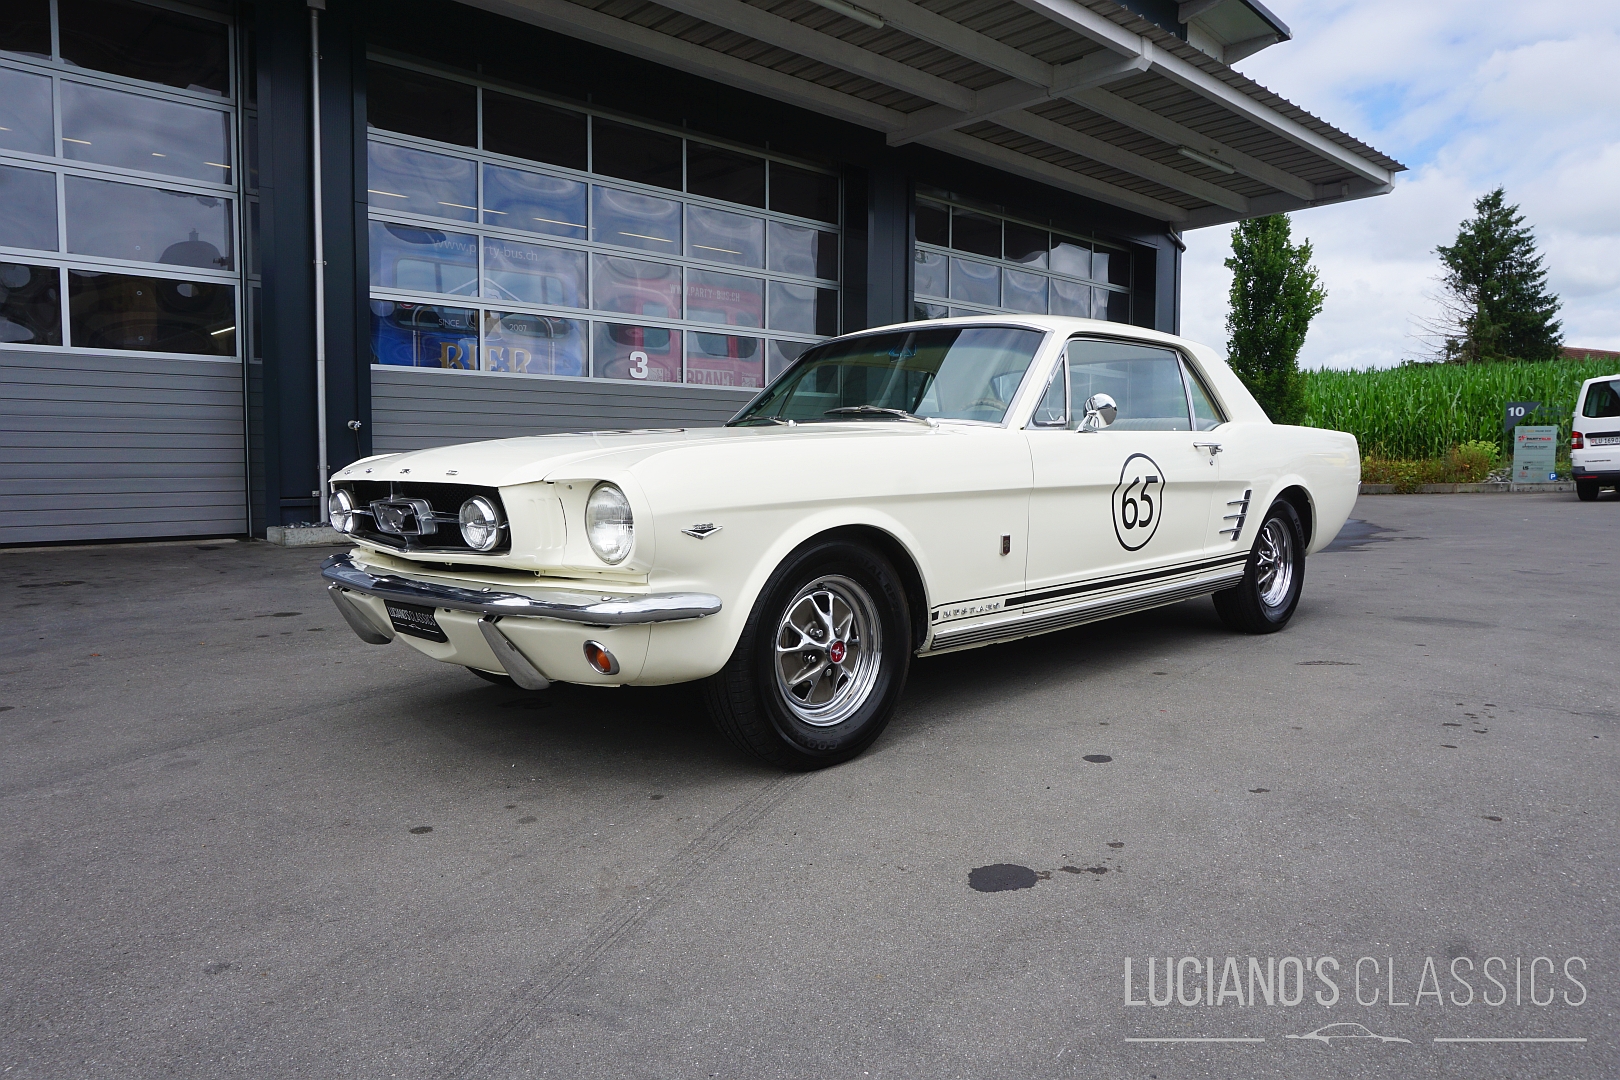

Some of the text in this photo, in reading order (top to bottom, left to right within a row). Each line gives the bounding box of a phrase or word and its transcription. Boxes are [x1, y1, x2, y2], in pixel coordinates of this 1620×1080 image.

[433, 238, 538, 261] www.prty-bus.ch
[438, 318, 527, 332] SINCE 2007
[629, 351, 648, 379] 3
[1508, 406, 1525, 417] 10
[1122, 476, 1157, 529] 65
